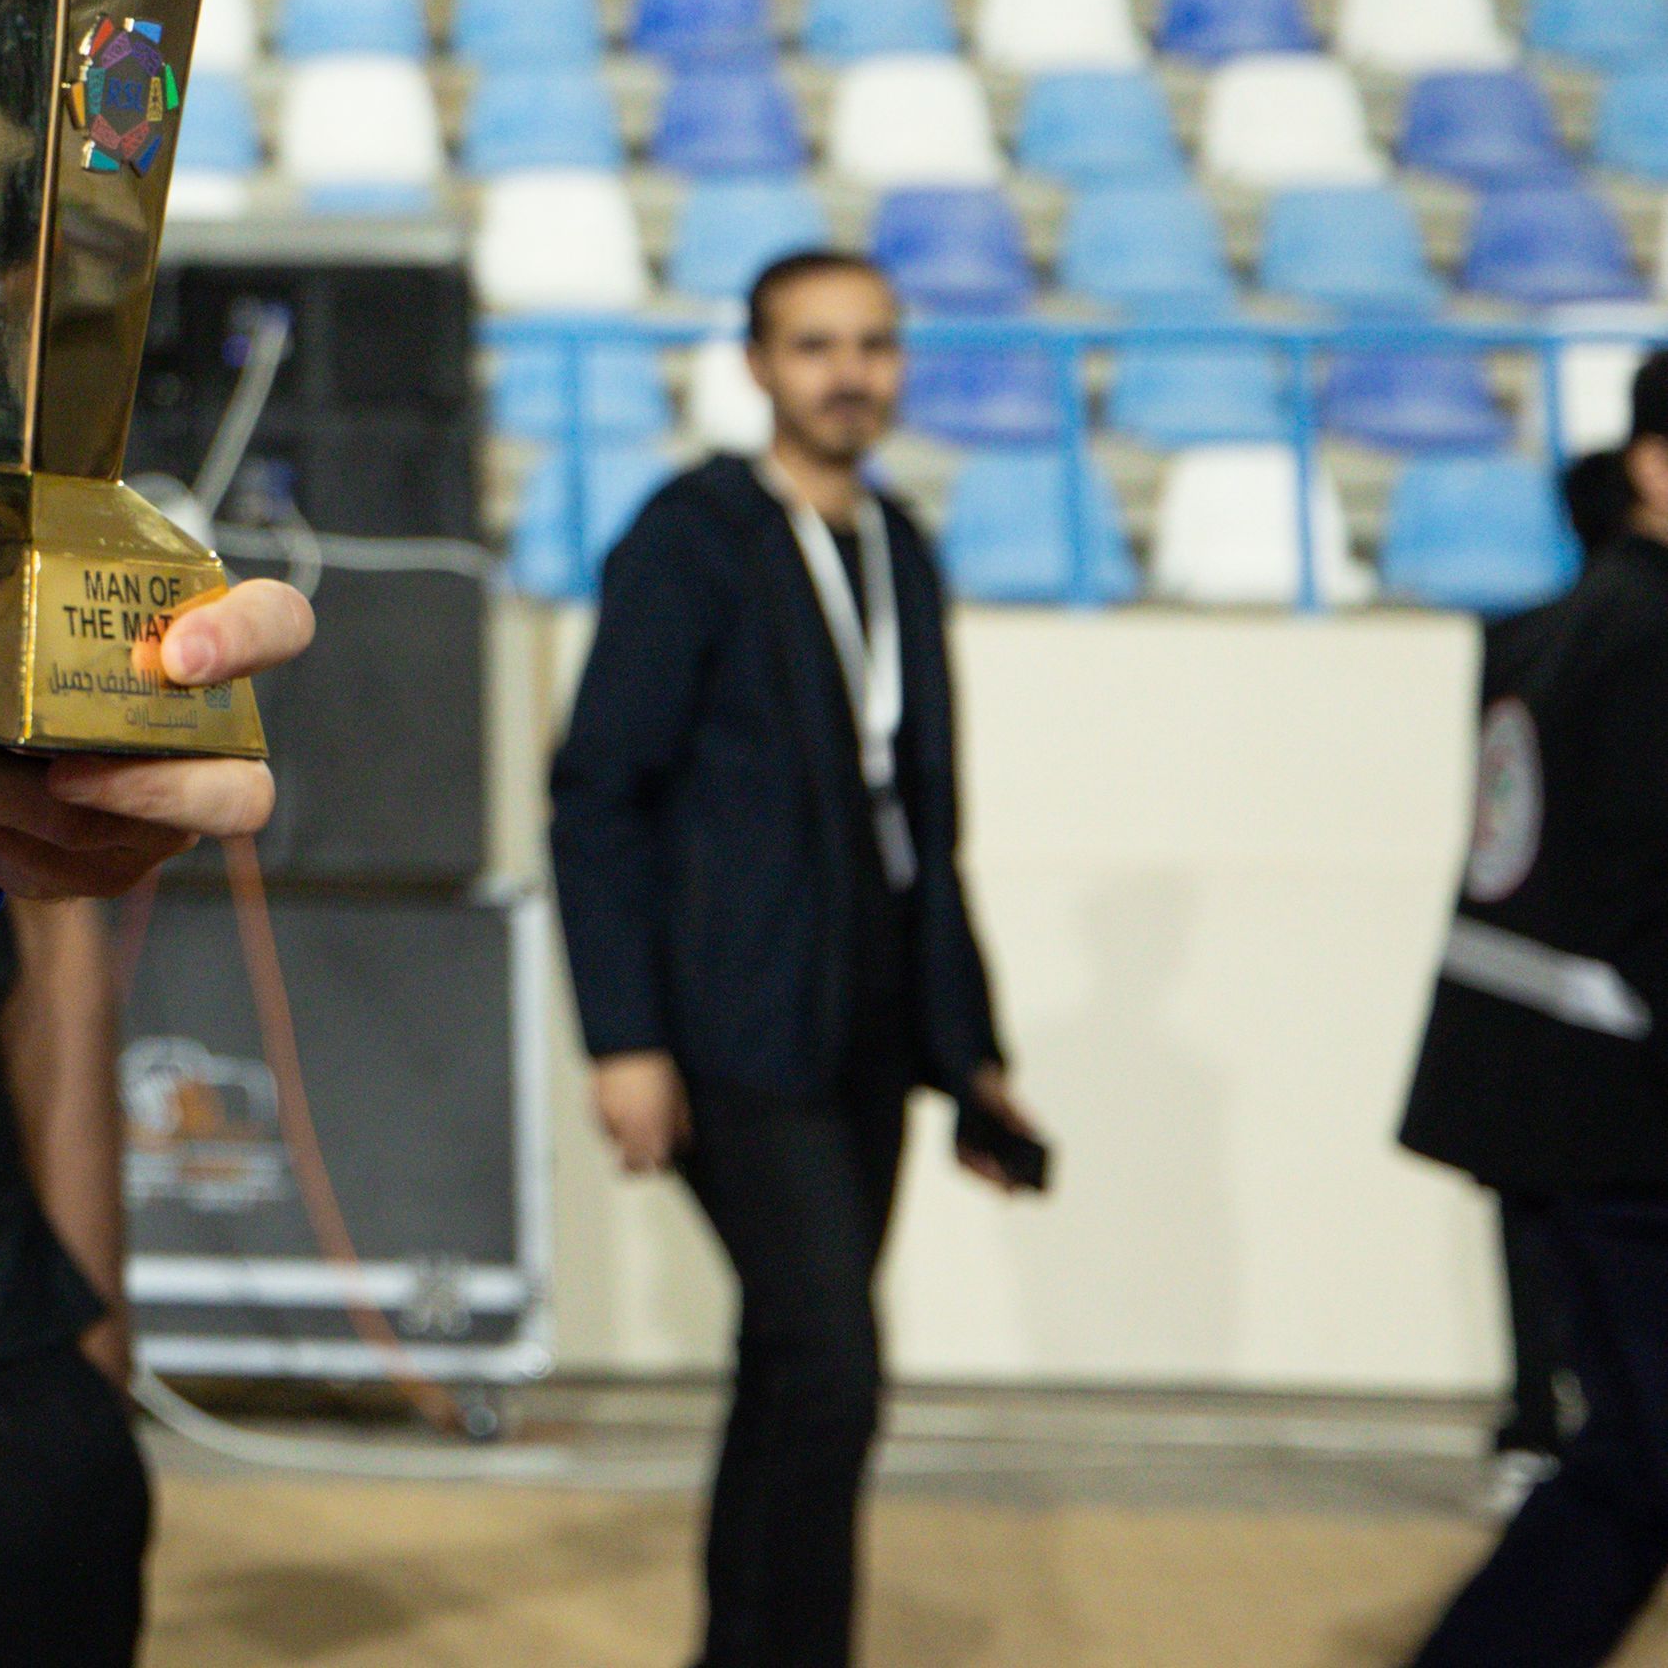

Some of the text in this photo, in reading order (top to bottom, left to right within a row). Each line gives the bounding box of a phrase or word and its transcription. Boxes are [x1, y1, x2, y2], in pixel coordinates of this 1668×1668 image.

[84, 570, 181, 608] MAN OF
[63, 606, 175, 644] THE MAT
